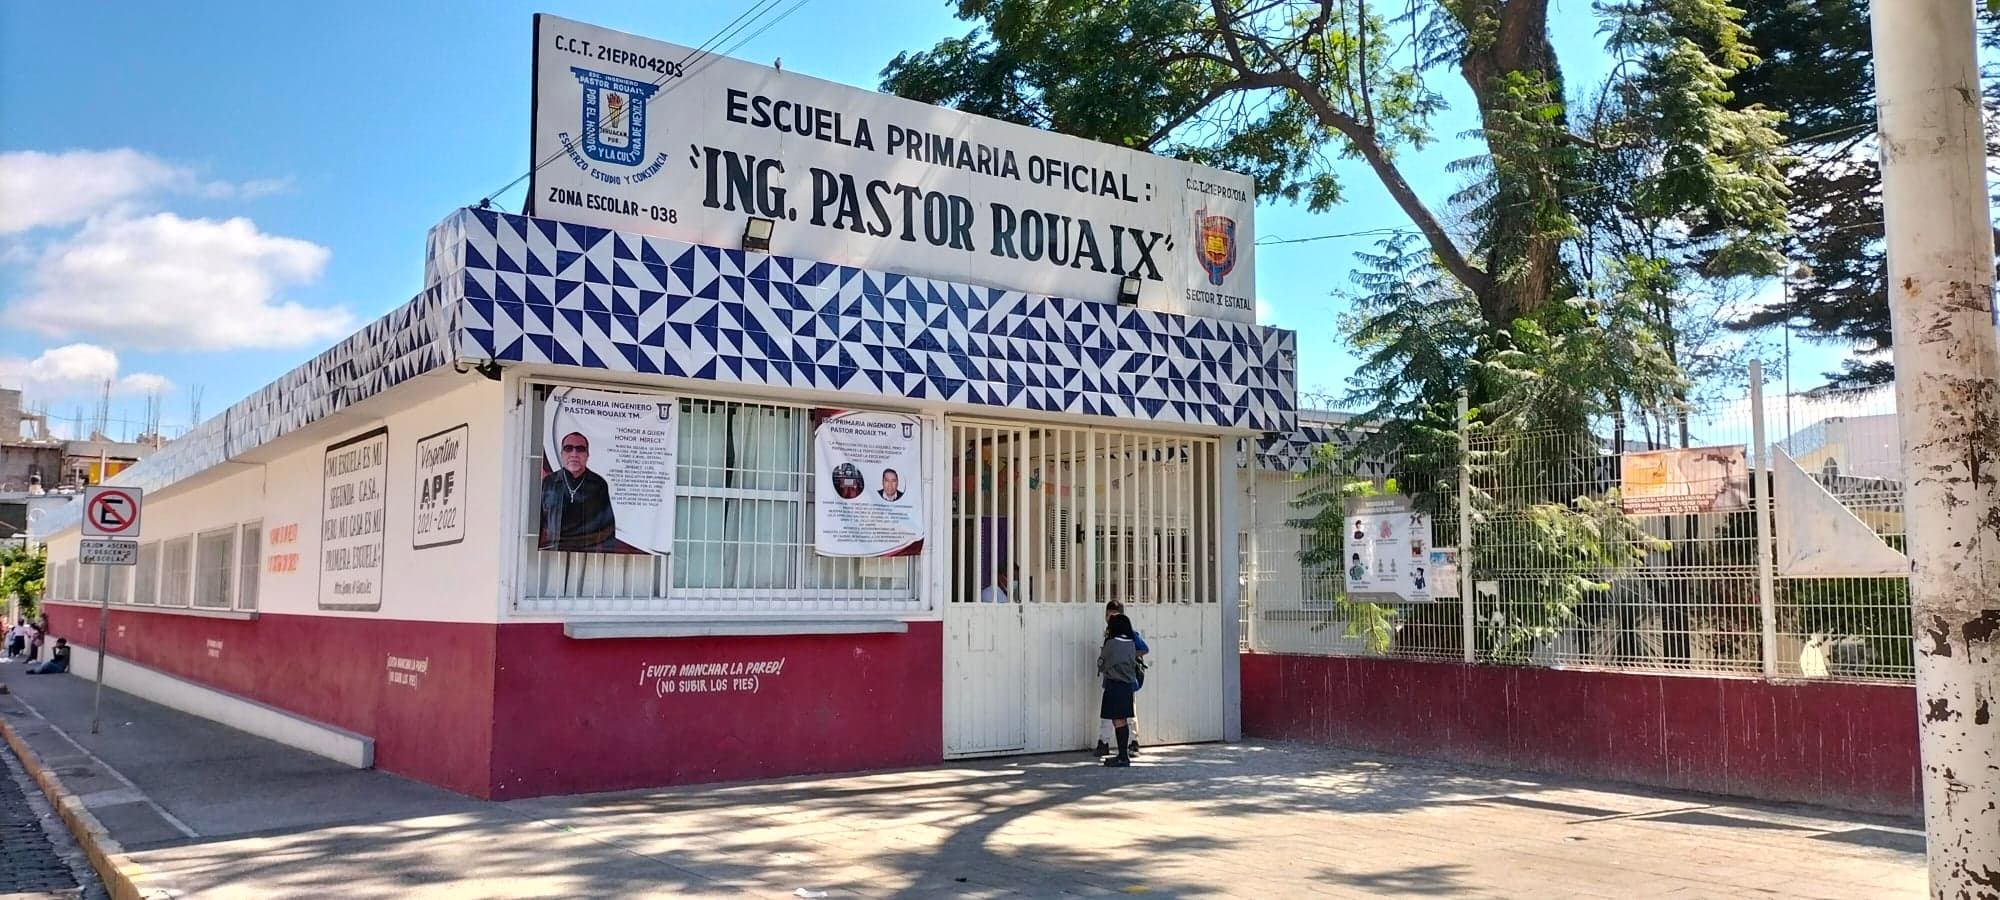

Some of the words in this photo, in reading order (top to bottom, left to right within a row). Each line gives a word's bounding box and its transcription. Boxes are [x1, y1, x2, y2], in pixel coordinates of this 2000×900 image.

[555, 35, 593, 57] C.C.T.
[580, 75, 610, 89] PASTOR
[727, 88, 875, 152] ESCUELA
[887, 124, 1021, 181] PRIMARIA
[559, 132, 589, 171] ESFUERZO
[591, 168, 622, 185] ESTUDIO
[623, 175, 631, 185] Y
[632, 151, 669, 184] CONSTANCIA
[548, 187, 583, 207] ZONA
[586, 193, 639, 217] ESCOLAR
[650, 205, 678, 225] 038
[809, 167, 976, 252] PASTOR
[1186, 288, 1215, 305] SECTOR
[564, 406, 595, 415] PASTOR
[597, 410, 627, 419] ROUAIX
[572, 398, 610, 408] PRIMARIA
[611, 402, 653, 411] INGENIERO
[836, 419, 866, 427] PRIMARIA
[338, 449, 361, 475] ESCUELA
[363, 446, 371, 469] ES
[371, 442, 382, 467] MI
[329, 483, 355, 509] SEGUNDA
[350, 512, 363, 536] CASA
[364, 511, 372, 535] ES
[372, 508, 382, 533] MI
[639, 661, 676, 687] ¡EVITA
[679, 663, 728, 677] MANCHAR
[730, 662, 743, 675] LA
[745, 656, 786, 676] PARED!
[656, 678, 675, 698] (NO
[679, 679, 708, 692] SUBIR
[711, 679, 728, 692] LOS
[733, 675, 759, 694] PIES)
